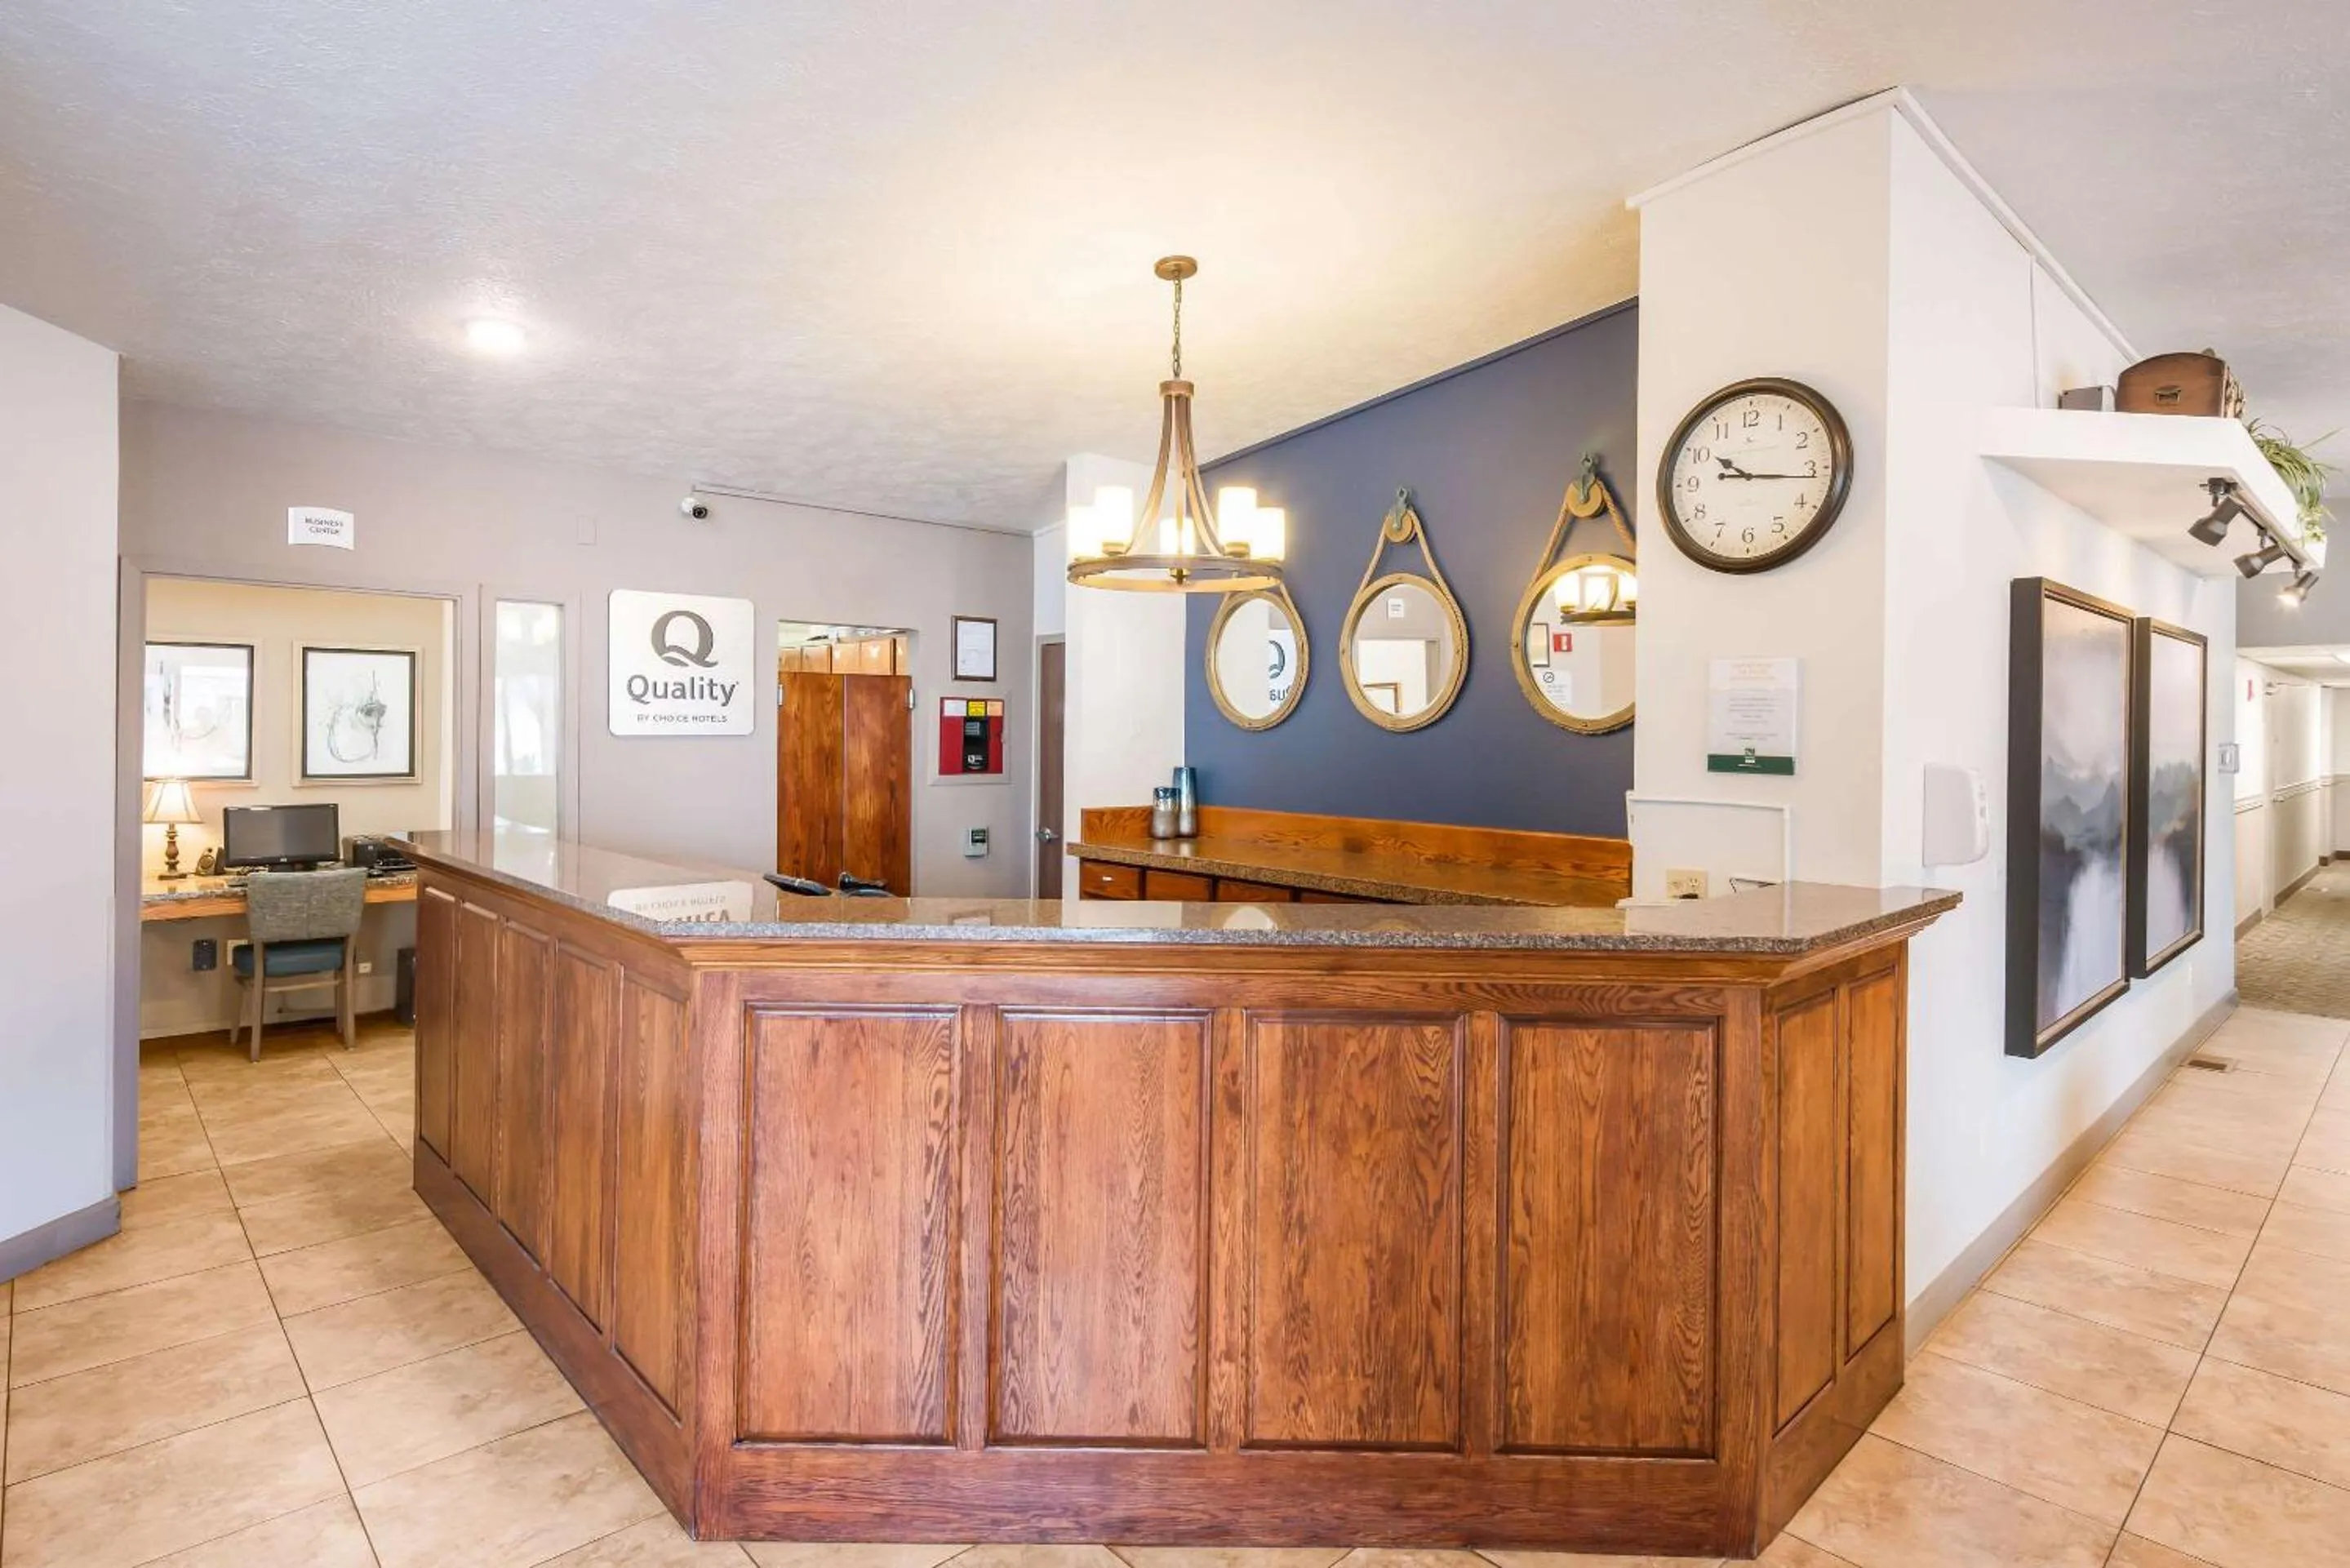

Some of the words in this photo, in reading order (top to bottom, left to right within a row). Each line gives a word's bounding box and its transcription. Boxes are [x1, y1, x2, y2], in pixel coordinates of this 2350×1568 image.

[1743, 410, 1759, 428] 12
[1778, 413, 1783, 431] 1
[1715, 423, 1729, 441] 11
[1795, 432, 1808, 450] 2
[1693, 446, 1710, 464] 10
[1805, 460, 1817, 478] 3
[1687, 476, 1699, 493] 9
[1794, 493, 1807, 509] 4
[1694, 504, 1706, 520] 8
[1715, 522, 1726, 539] 7
[1771, 516, 1785, 534] 5
[1741, 526, 1755, 544] 6
[651, 610, 718, 669] Q
[626, 674, 737, 707] Quality
[652, 714, 689, 723] CHOICE
[692, 714, 728, 723] HOTELS
